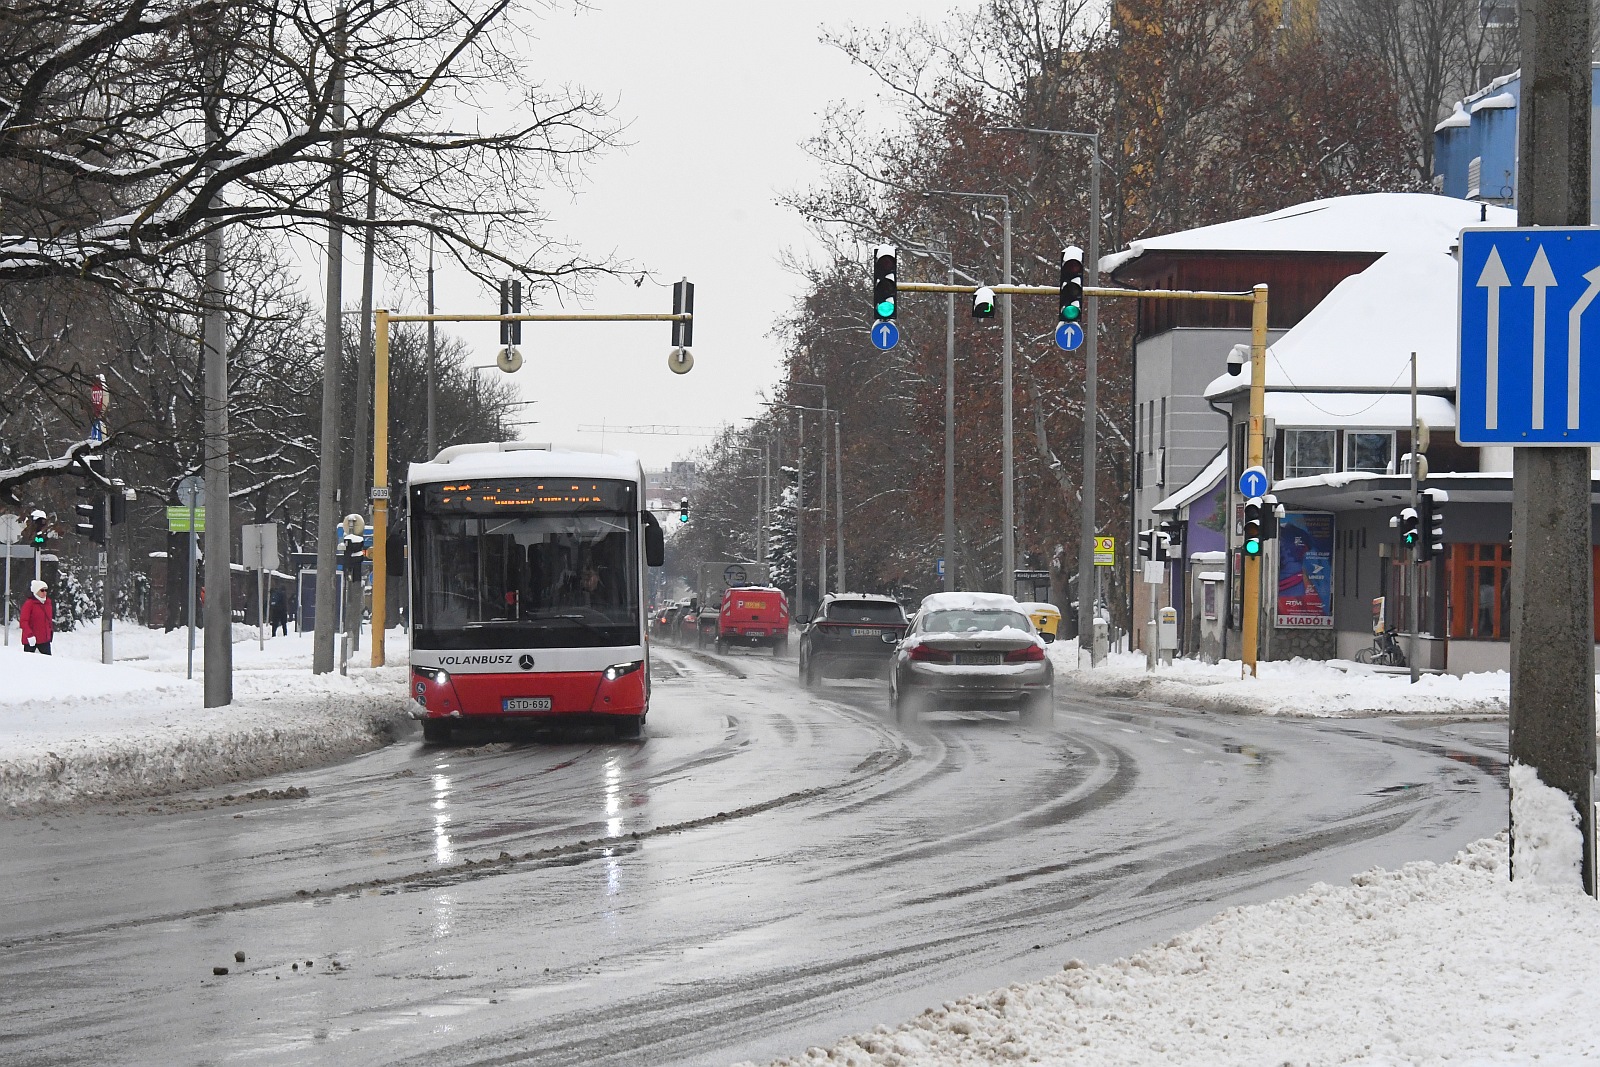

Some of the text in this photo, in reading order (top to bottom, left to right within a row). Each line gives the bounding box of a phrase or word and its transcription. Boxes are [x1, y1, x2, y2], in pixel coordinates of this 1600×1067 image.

[92, 390, 102, 404] STOP
[373, 489, 388, 497] G039
[1286, 616, 1324, 625] KIADÓ!
[509, 700, 549, 709] STD-692
